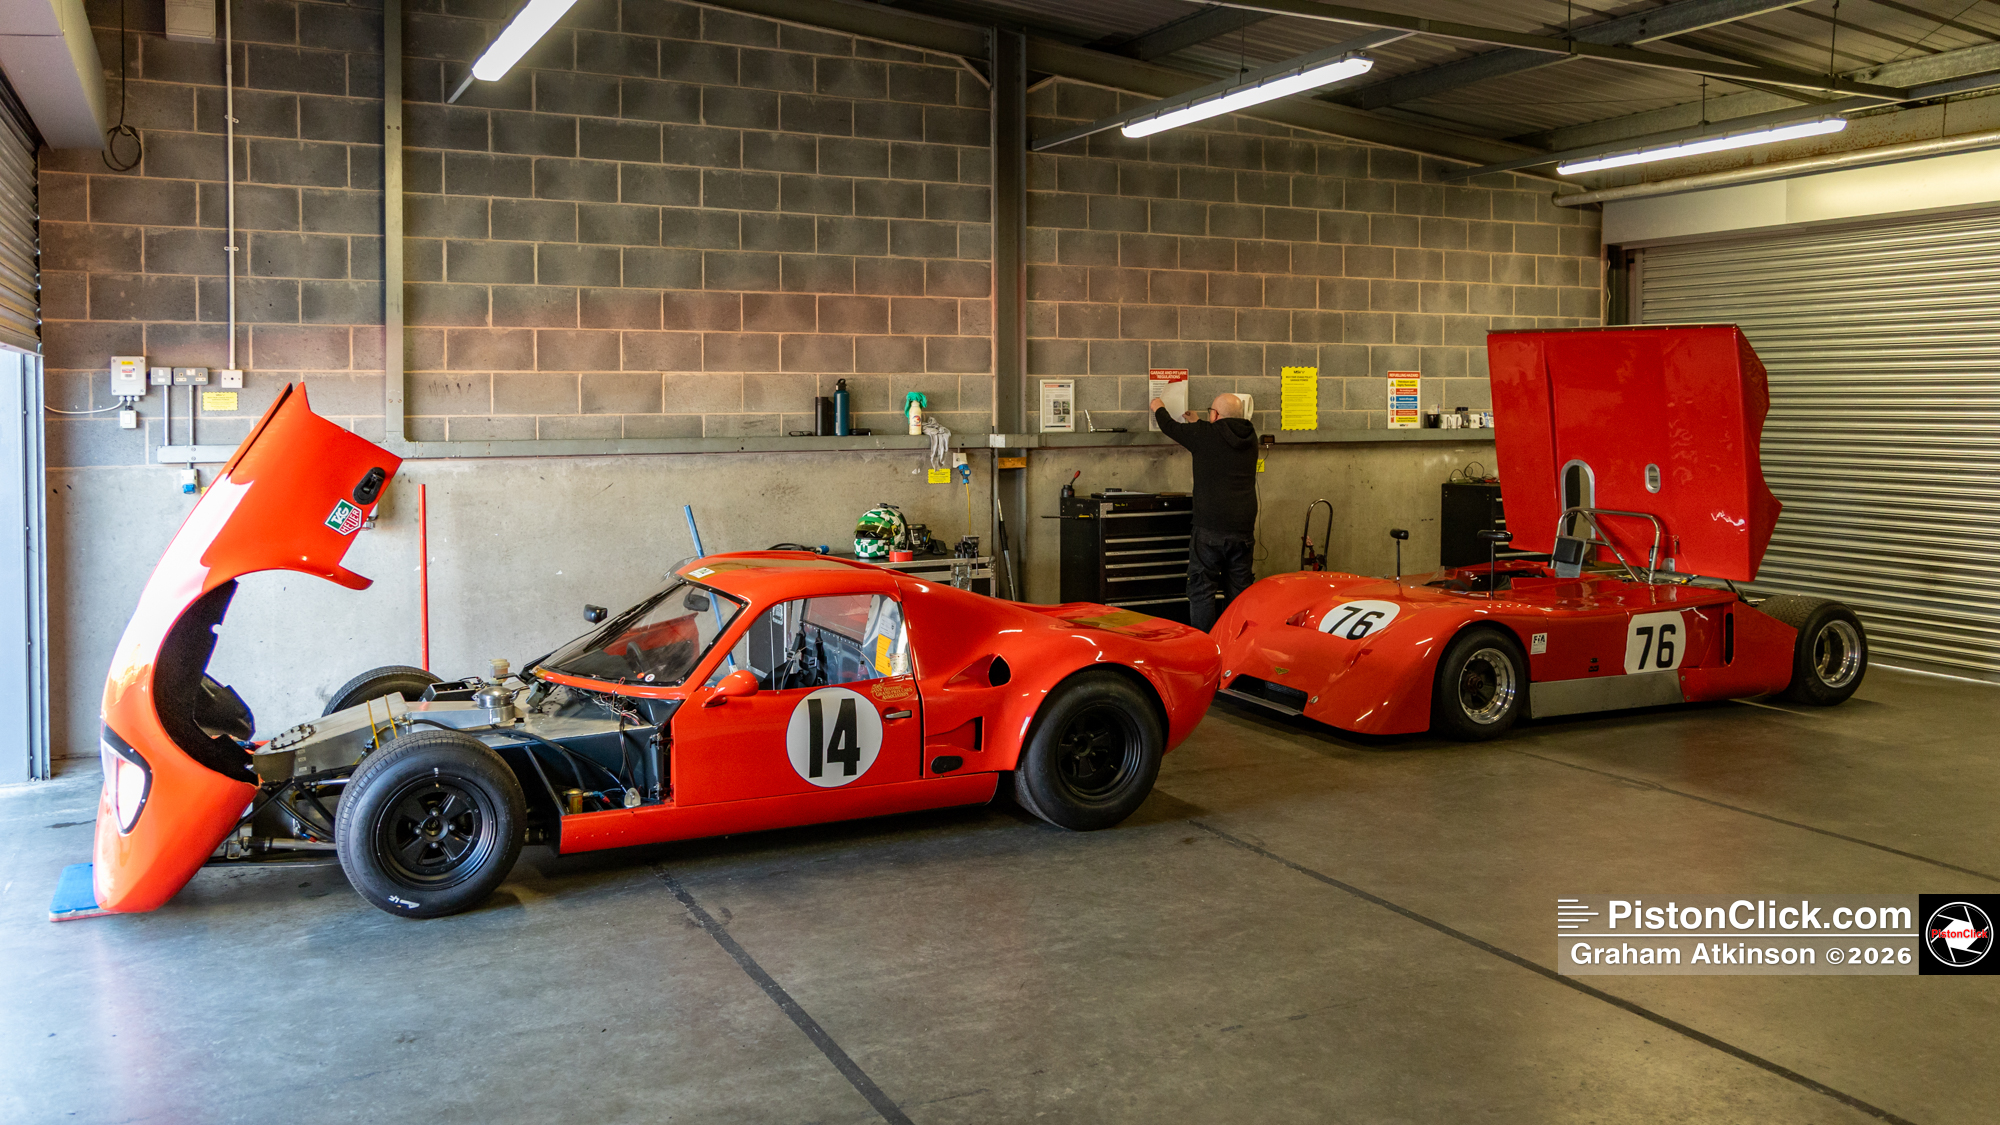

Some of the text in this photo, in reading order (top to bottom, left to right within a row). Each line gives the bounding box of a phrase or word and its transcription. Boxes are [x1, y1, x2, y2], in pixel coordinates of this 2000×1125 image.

[331, 507, 349, 525] TAG
[340, 509, 359, 533] HEUER
[1328, 606, 1385, 640] 76
[1636, 624, 1676, 670] 76
[807, 698, 860, 778] 14
